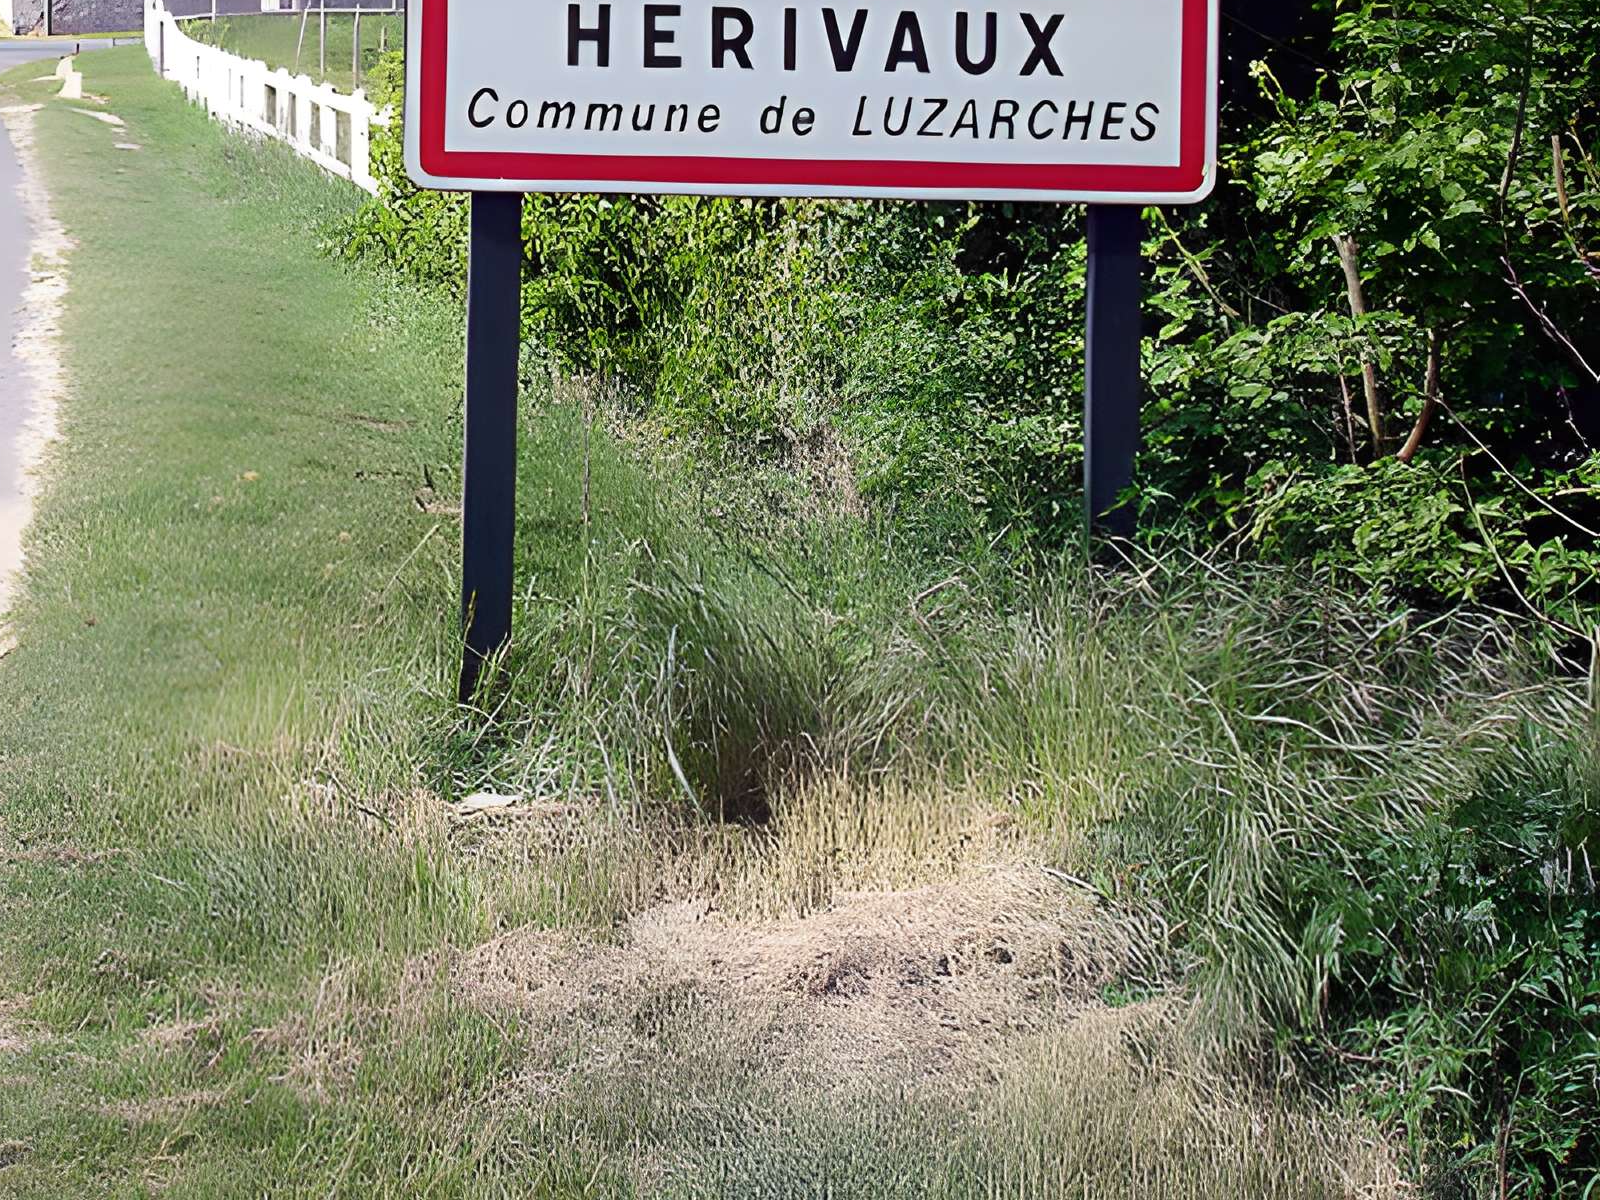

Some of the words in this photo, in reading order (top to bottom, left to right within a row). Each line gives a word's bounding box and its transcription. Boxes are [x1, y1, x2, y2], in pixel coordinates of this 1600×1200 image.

[566, 2, 1066, 78] HERIVAUX
[466, 86, 722, 134] Commune
[758, 94, 816, 138] de
[851, 95, 1161, 143] LUZARCHES
